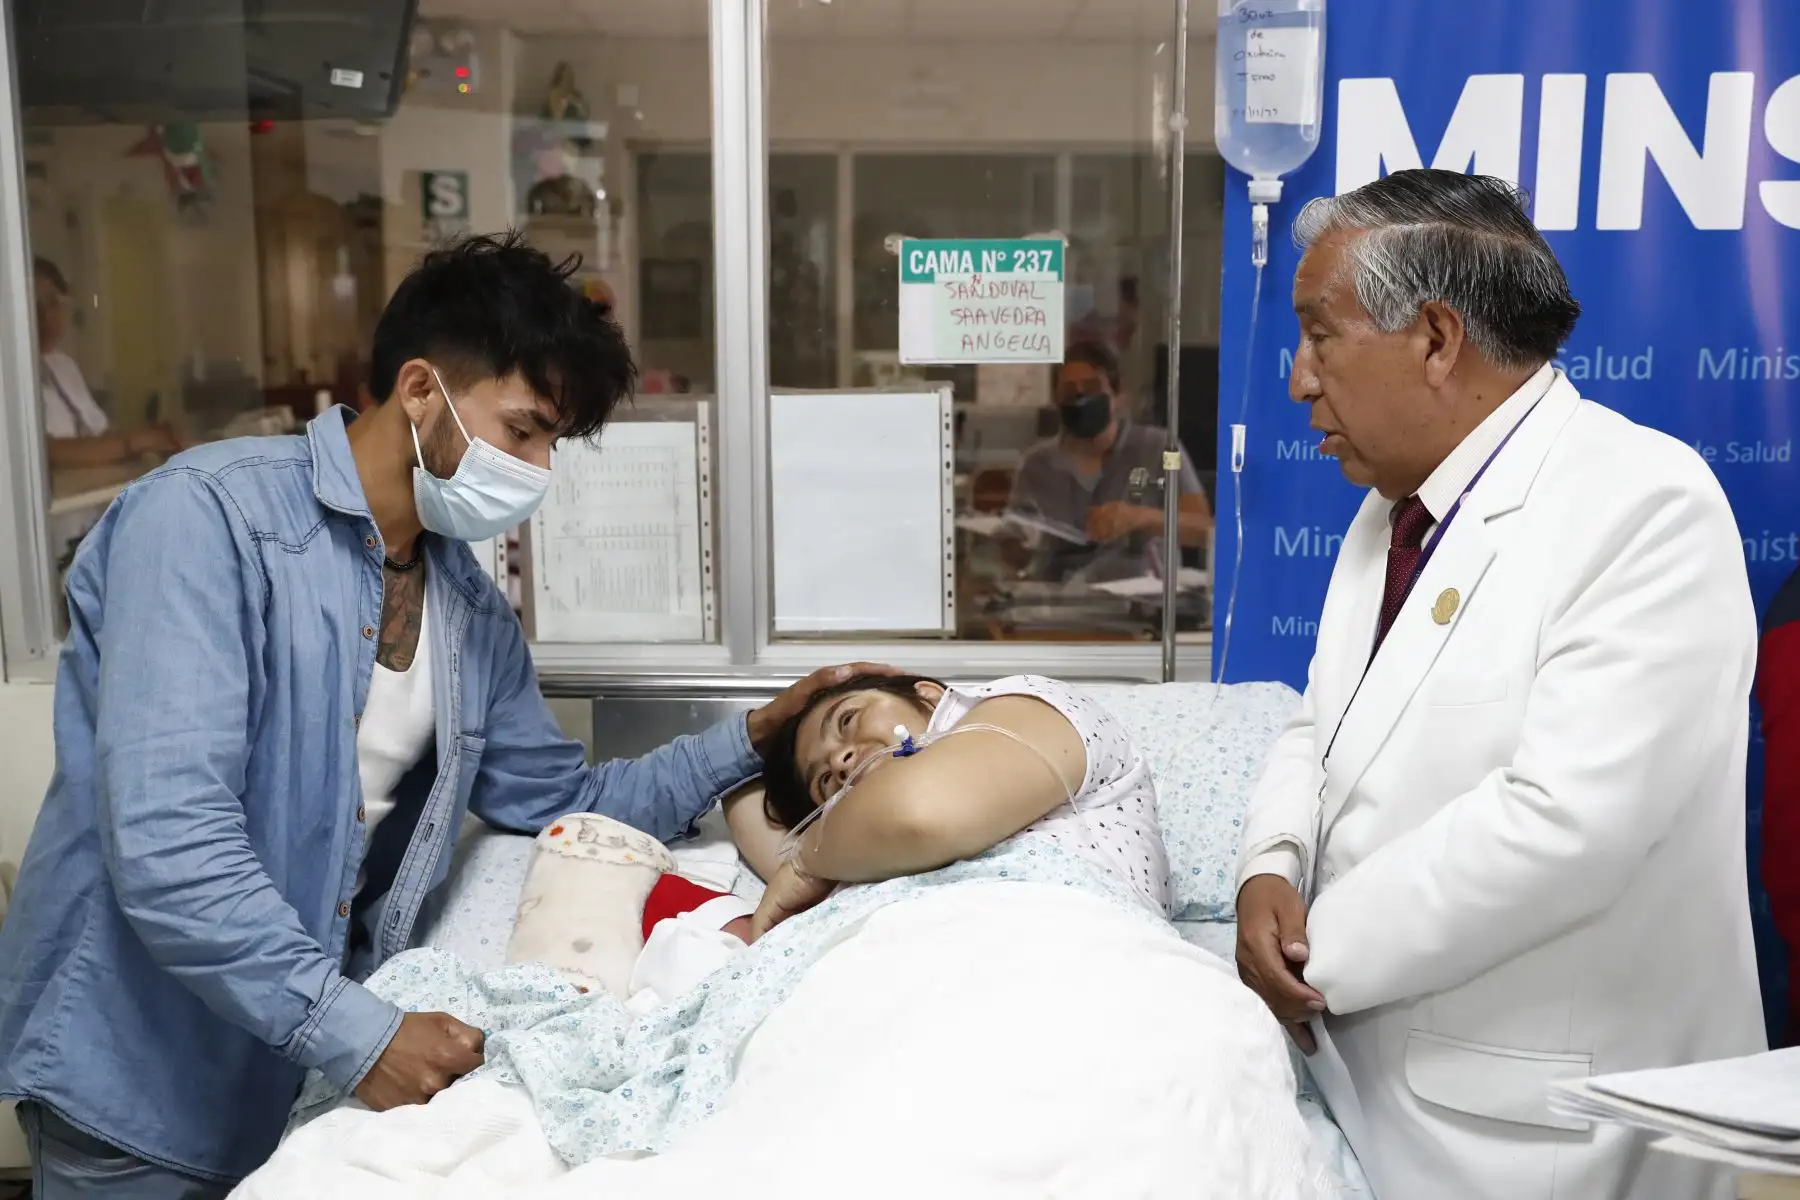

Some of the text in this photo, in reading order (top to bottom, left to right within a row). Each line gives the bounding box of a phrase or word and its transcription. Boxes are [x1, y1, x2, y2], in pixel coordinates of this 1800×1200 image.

[429, 176, 464, 215] S
[909, 250, 974, 274] CAMA
[1013, 250, 1053, 273] 237
[951, 306, 1046, 326] SAAVEDRA
[1698, 346, 1800, 380] Minis
[1725, 440, 1791, 463] Salud
[1271, 616, 1317, 637] Min
